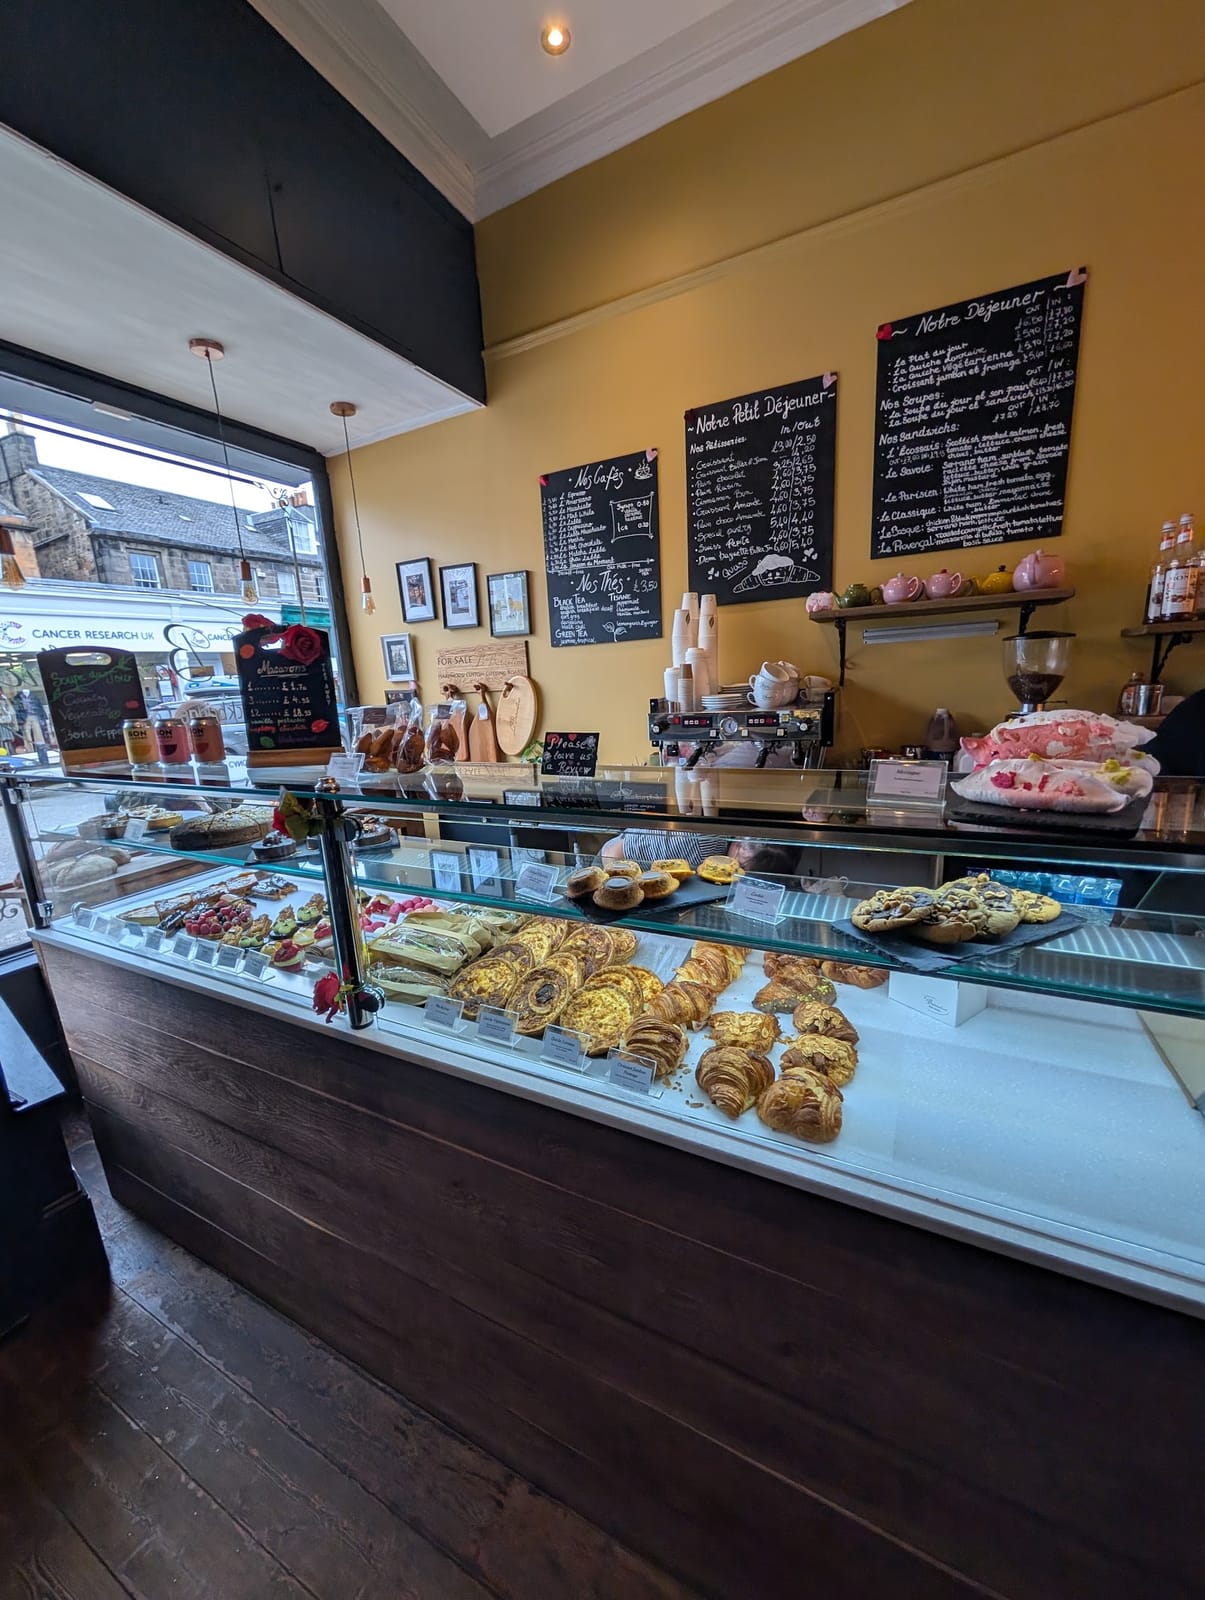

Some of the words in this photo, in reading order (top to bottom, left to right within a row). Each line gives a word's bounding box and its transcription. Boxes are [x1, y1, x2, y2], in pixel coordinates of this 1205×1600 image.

[915, 312, 960, 336] Notre
[964, 290, 1045, 322] Déjeuner
[909, 360, 941, 372] Quiche
[892, 375, 935, 393] Croissant
[980, 360, 1021, 377] fromage
[909, 368, 941, 380] Quiche
[880, 400, 900, 411] Nos
[696, 414, 730, 435] Notre
[732, 400, 761, 425] Petit
[879, 434, 898, 446] Nos
[690, 443, 704, 455] Nos
[696, 451, 735, 471] Croissant
[574, 466, 593, 490] Nos
[594, 465, 624, 491] Cafés
[617, 522, 629, 533] Ice
[576, 573, 598, 594] Nos
[599, 570, 624, 594] Thés
[32, 630, 81, 639] CANCER
[85, 631, 139, 640] RESEARCH
[141, 632, 156, 641] UK
[437, 657, 454, 666] FOR
[454, 656, 473, 665] SALE
[257, 661, 307, 675] Macarons
[547, 738, 586, 750] Please
